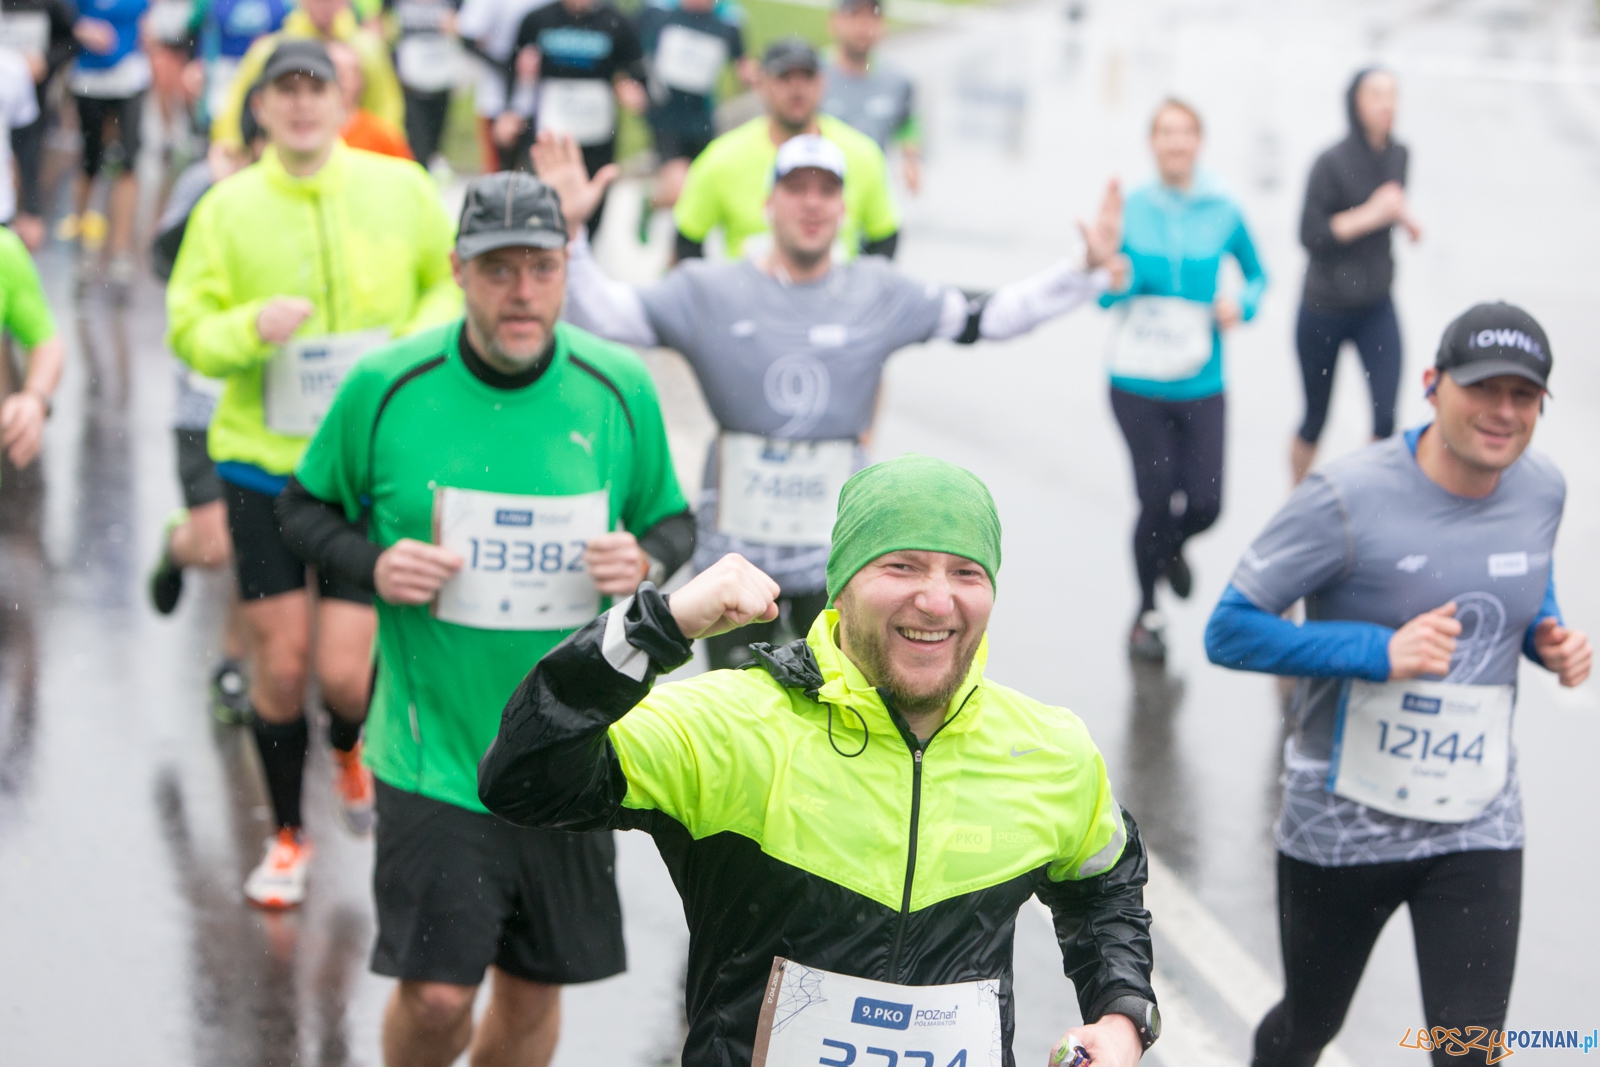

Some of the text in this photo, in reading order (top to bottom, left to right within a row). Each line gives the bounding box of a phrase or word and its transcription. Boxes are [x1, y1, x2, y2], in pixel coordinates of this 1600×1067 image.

[469, 538, 587, 573] 13382
[1377, 718, 1485, 765] 12144
[873, 1007, 904, 1023] PKO
